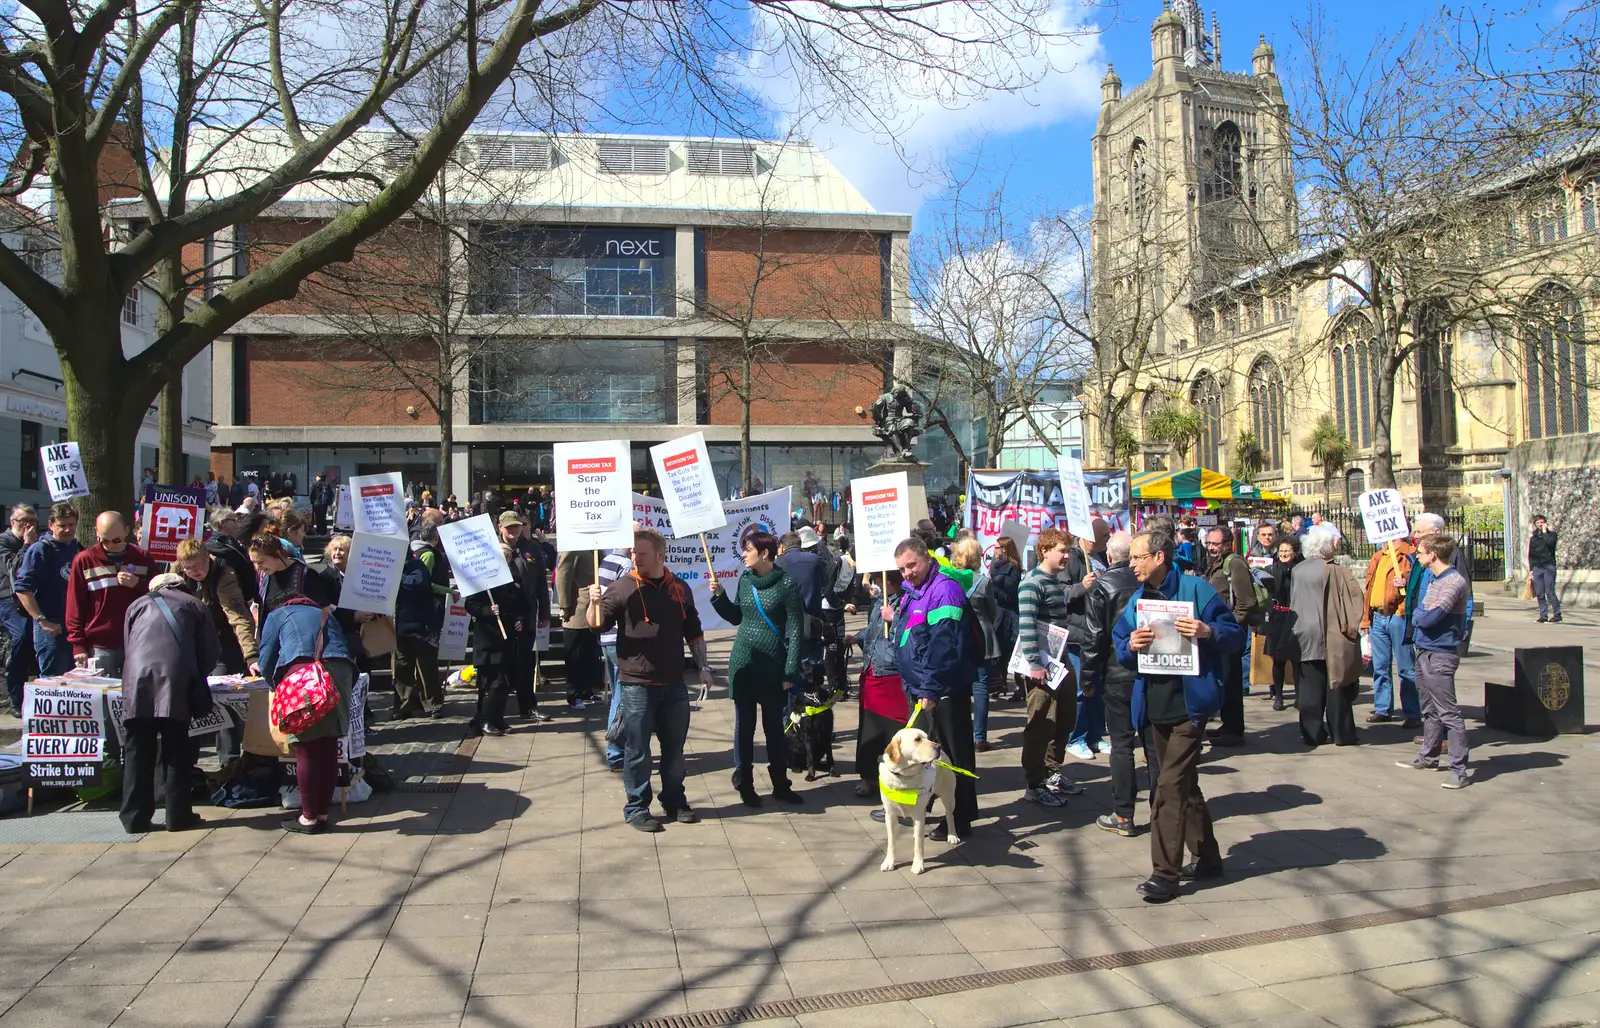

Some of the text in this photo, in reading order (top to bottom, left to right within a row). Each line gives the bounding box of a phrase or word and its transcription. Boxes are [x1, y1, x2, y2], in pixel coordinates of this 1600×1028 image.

[606, 240, 660, 255] next
[48, 444, 70, 462] AXE
[54, 474, 78, 491] TAX
[578, 474, 606, 484] Scrap
[584, 487, 600, 495] the
[679, 491, 702, 501] Disabled
[154, 492, 197, 504] UNISON
[570, 500, 616, 508] Bedroom
[1369, 490, 1391, 507] AXE
[633, 503, 651, 514] rap
[1377, 508, 1388, 516] THE
[584, 512, 602, 520] Tax
[732, 516, 752, 537] Norfolk
[1375, 517, 1398, 533] TAX
[471, 556, 495, 566] Everyone
[670, 555, 692, 565] Living
[361, 574, 386, 582] Attacking
[676, 571, 698, 579] ople
[1140, 654, 1192, 666] REJOICE!
[66, 690, 92, 698] Worker
[34, 699, 92, 716] NO CUTS
[28, 719, 99, 734] FIGHT FOR
[188, 714, 225, 730] EJOICE!
[27, 738, 98, 754] EVERY JOB
[30, 764, 94, 777] Strike to win
